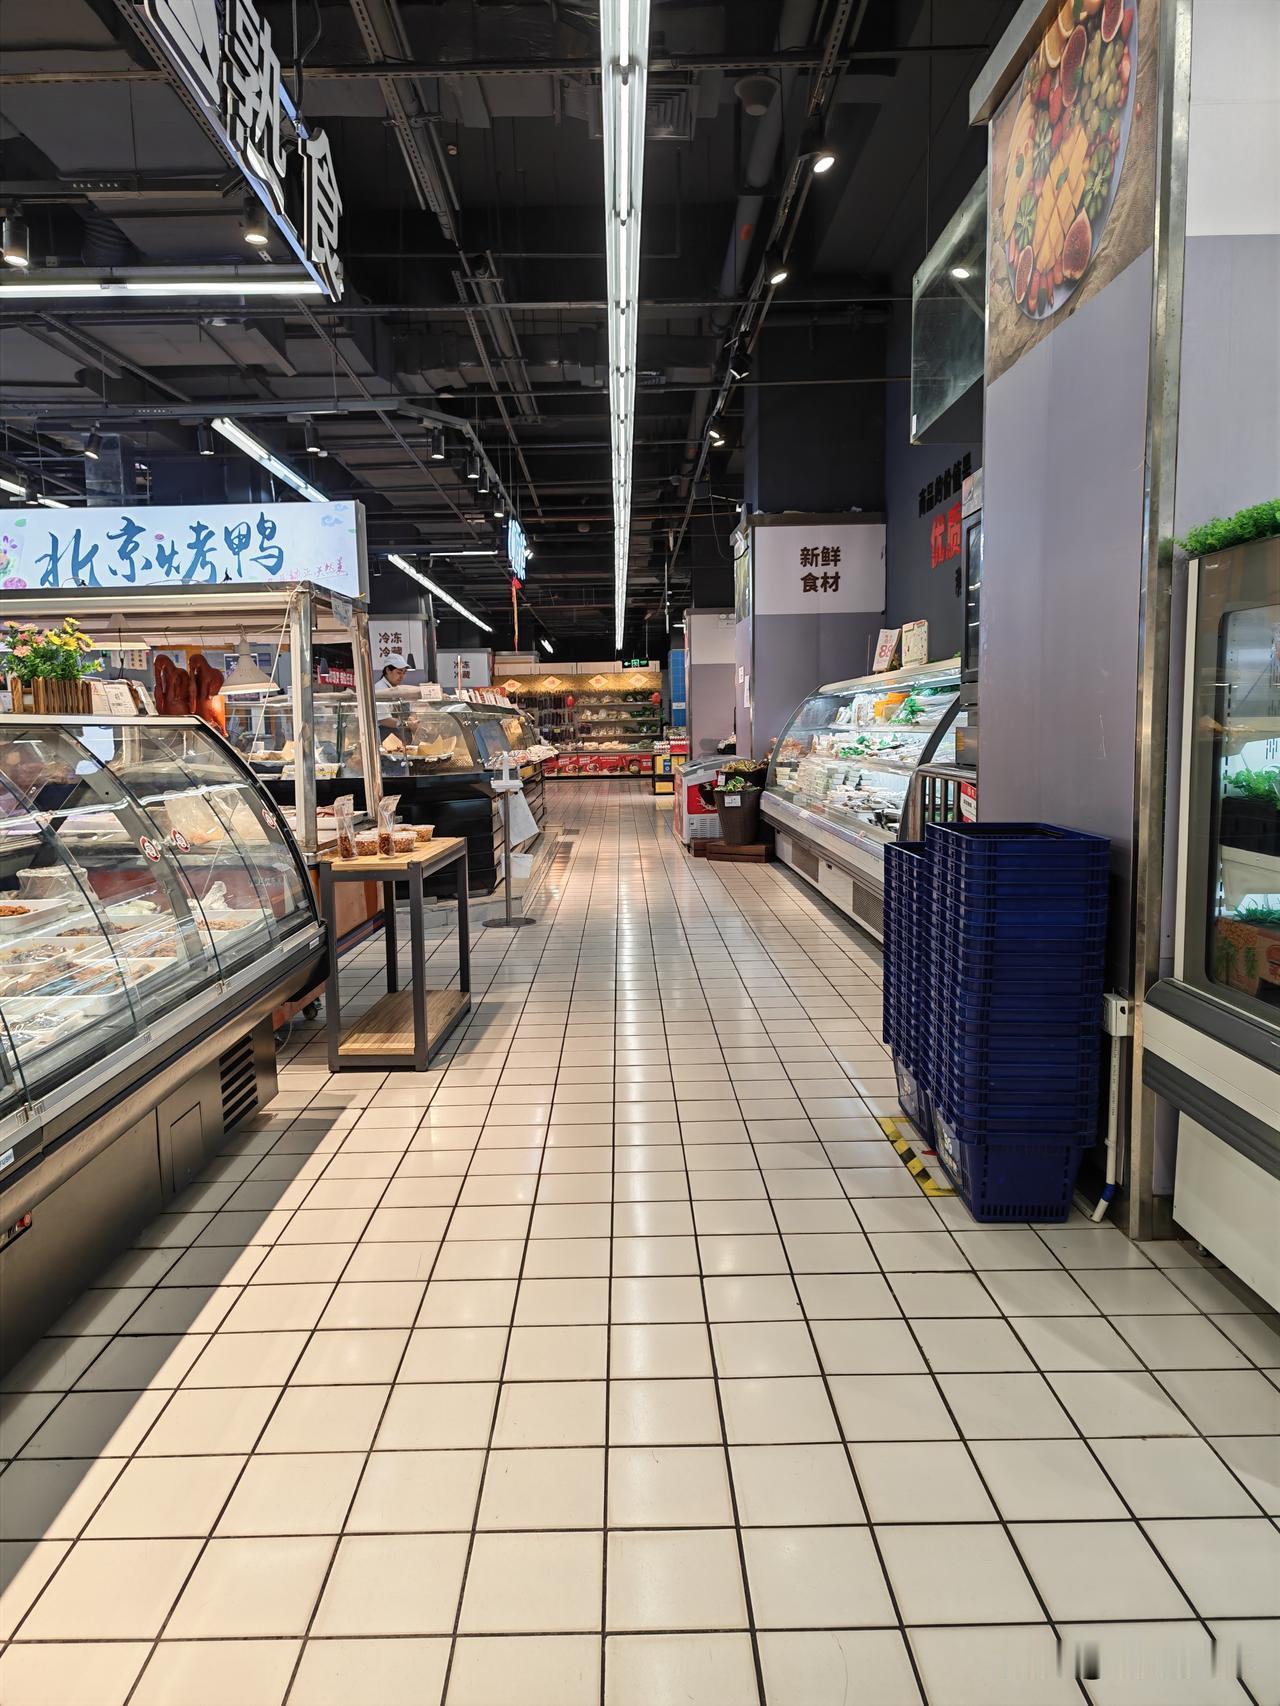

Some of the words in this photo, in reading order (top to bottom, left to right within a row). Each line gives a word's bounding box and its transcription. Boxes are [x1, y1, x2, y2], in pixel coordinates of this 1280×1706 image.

[222, 0, 343, 302] 熟食
[35, 511, 284, 587] 北京烤鸭
[800, 546, 841, 567] 新鲜
[800, 571, 841, 592] 食材
[378, 632, 402, 643] 冷冻
